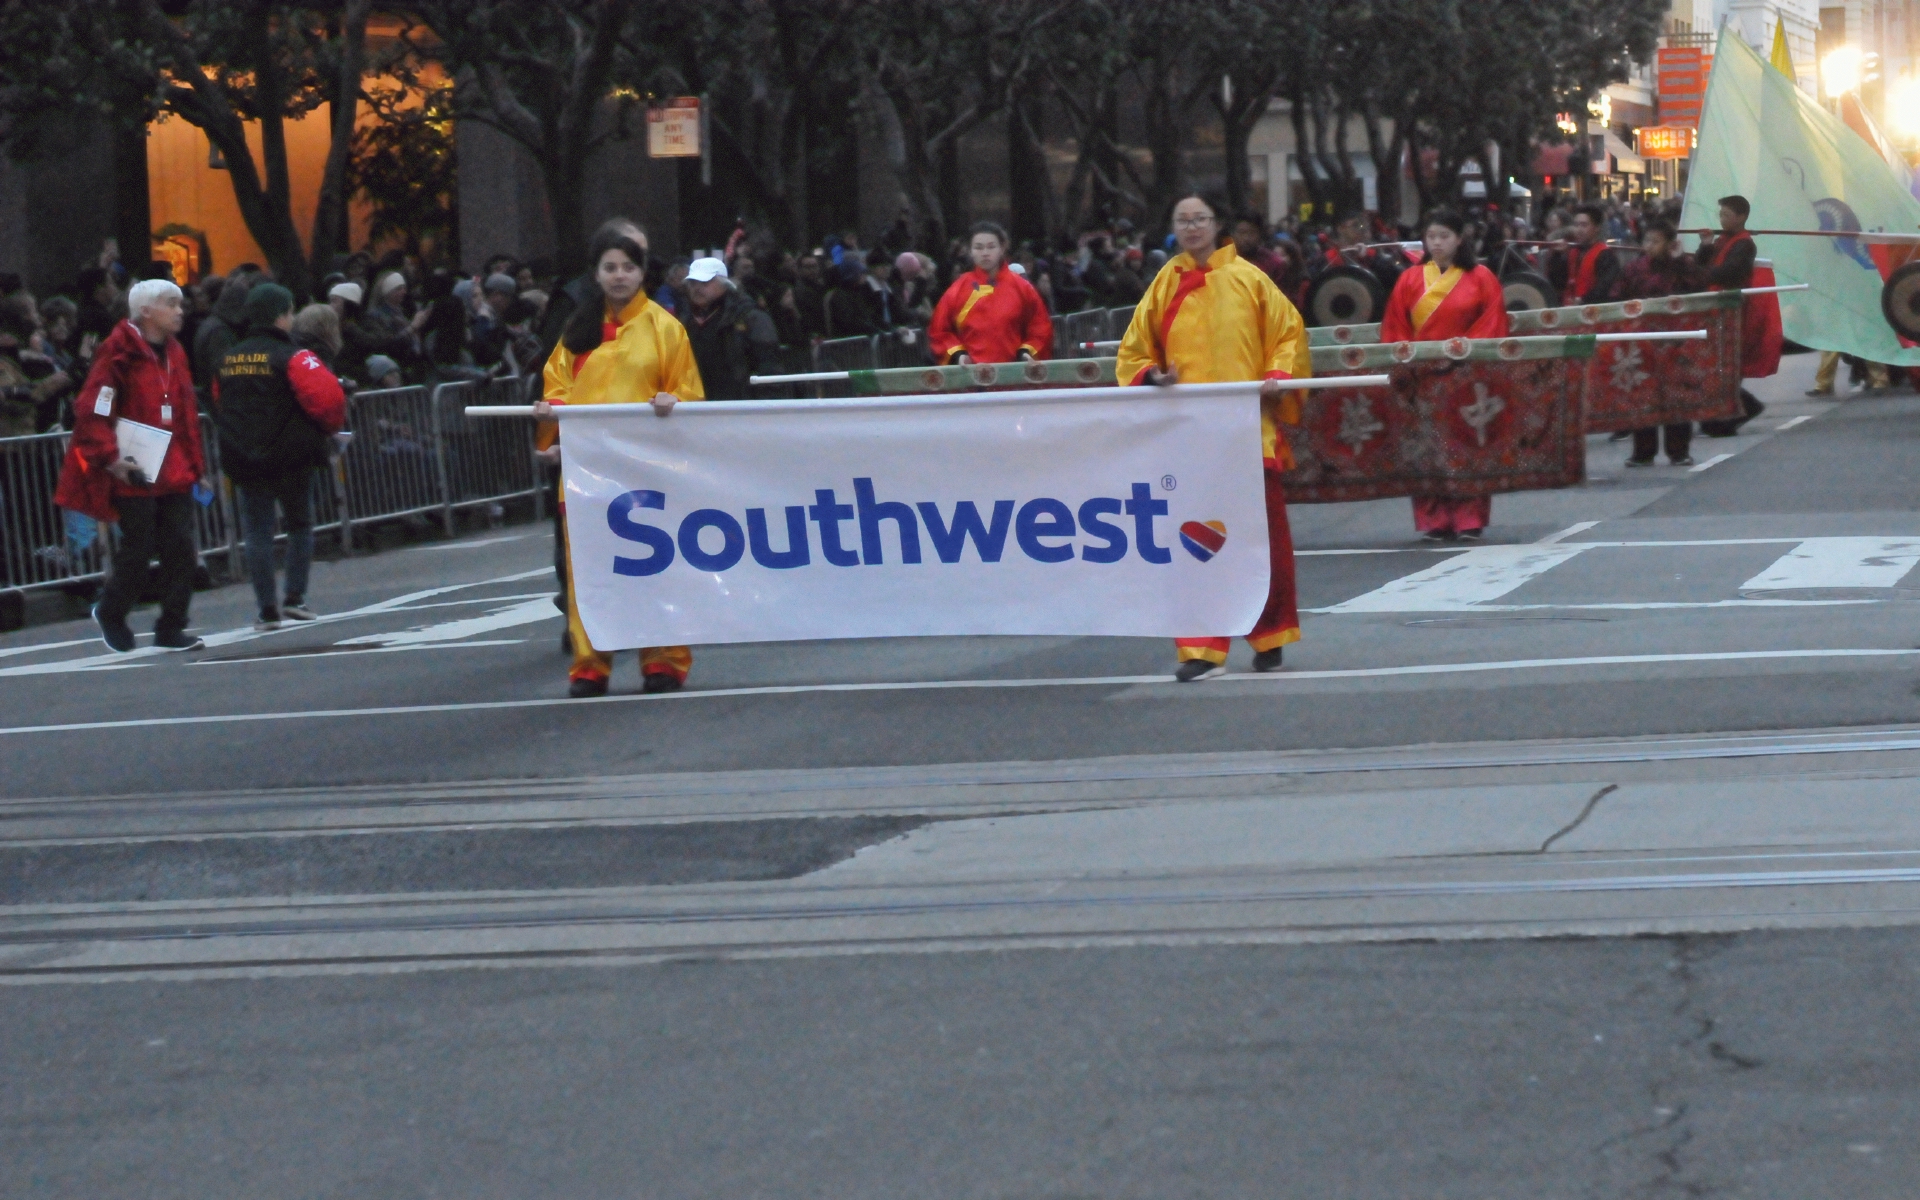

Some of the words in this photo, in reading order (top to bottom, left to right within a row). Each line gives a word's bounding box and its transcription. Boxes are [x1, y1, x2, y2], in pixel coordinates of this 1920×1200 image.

[664, 124, 683, 133] ANY
[664, 135, 685, 145] TIME
[1645, 130, 1686, 140] SUPER
[1644, 139, 1686, 149] DUPER
[224, 353, 270, 365] PARADE
[220, 365, 273, 377] MARSHAL
[607, 478, 1172, 577] Southwest
